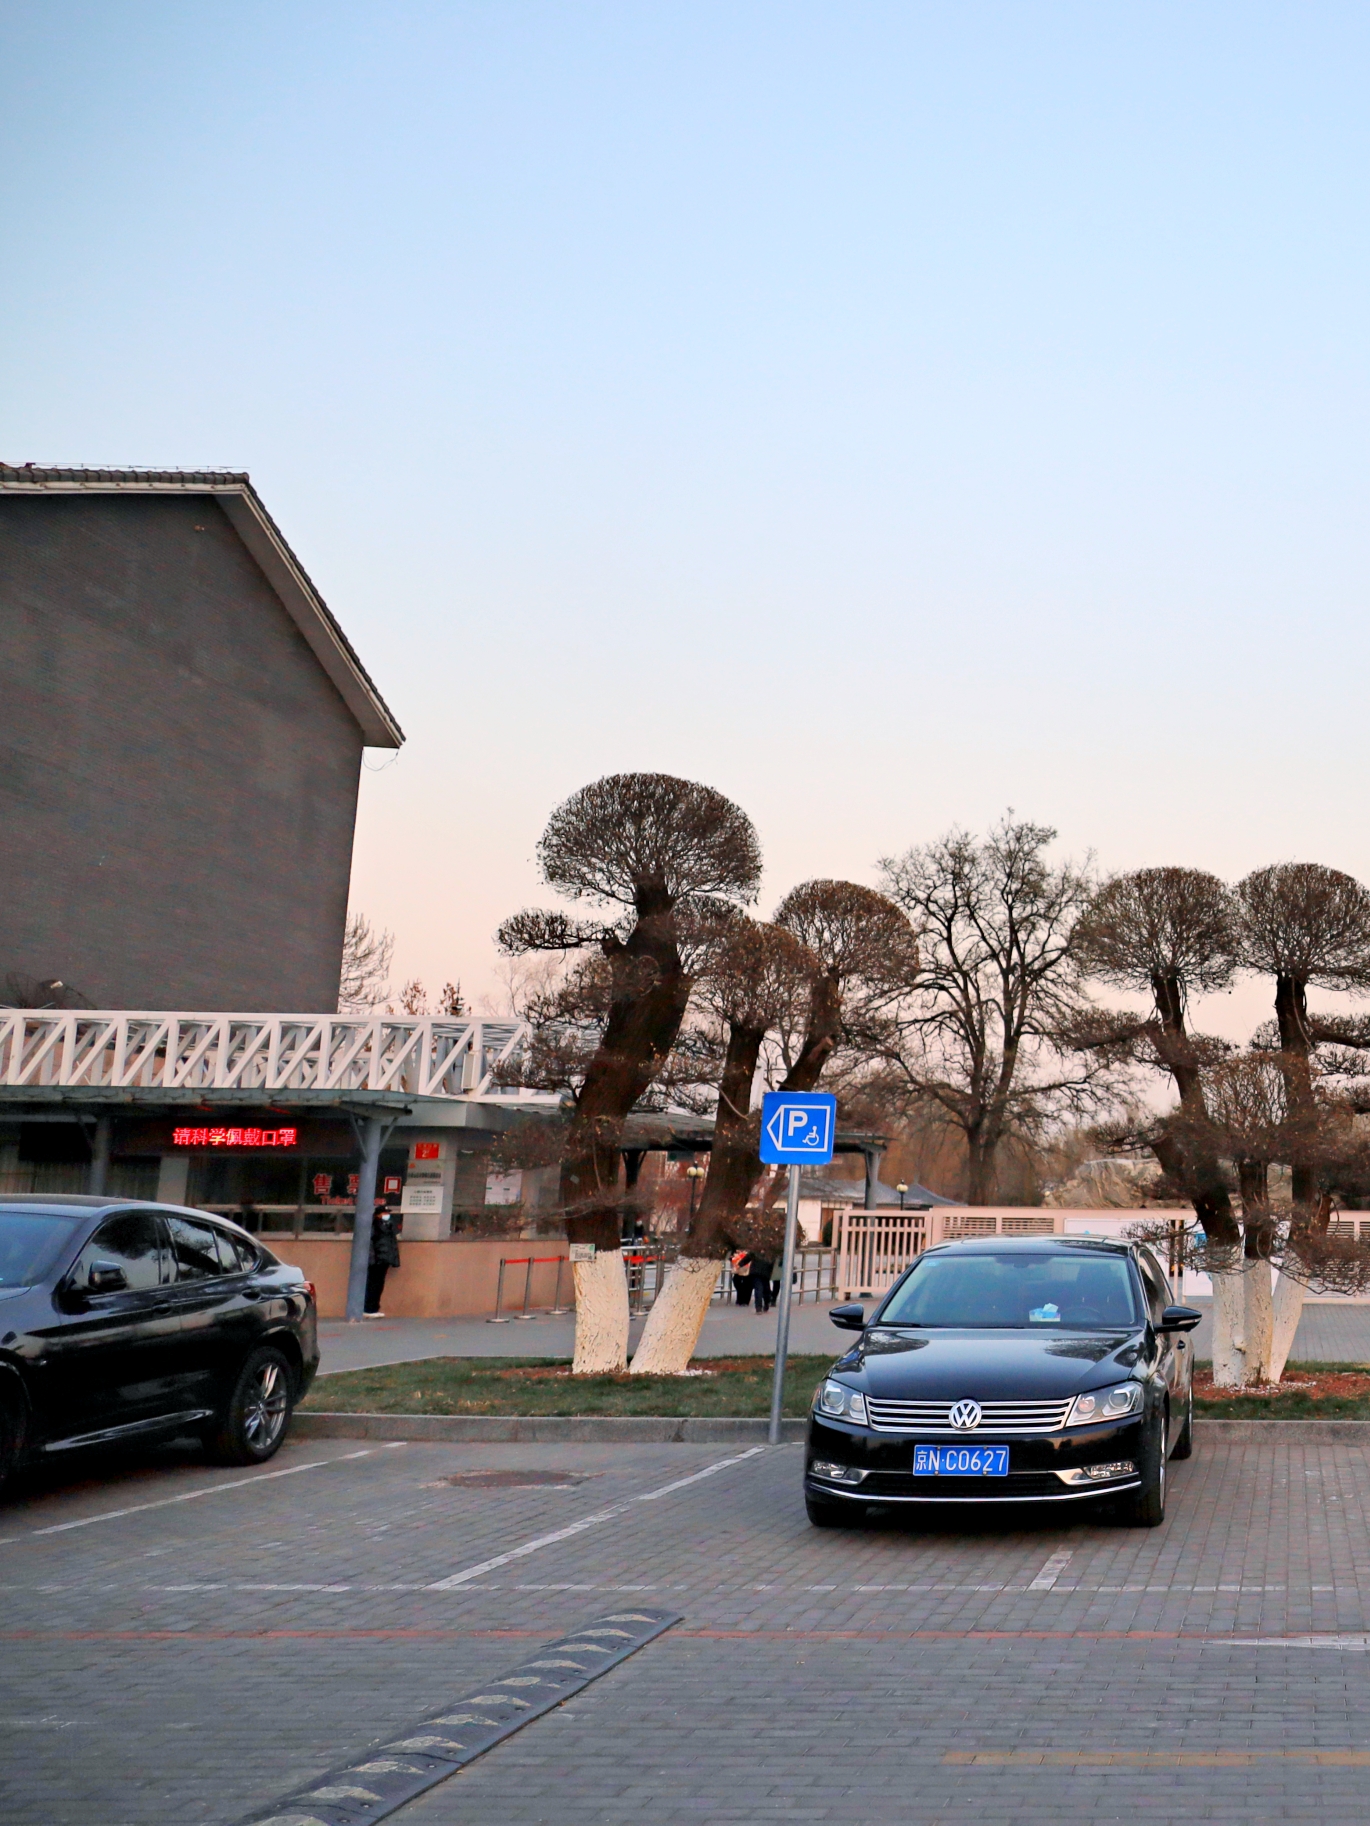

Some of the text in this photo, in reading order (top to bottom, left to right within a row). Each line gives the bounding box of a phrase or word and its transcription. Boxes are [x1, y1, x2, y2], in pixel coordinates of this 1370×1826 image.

[788, 1110, 808, 1136] P
[173, 1127, 297, 1146] 请科学佩戴口罩
